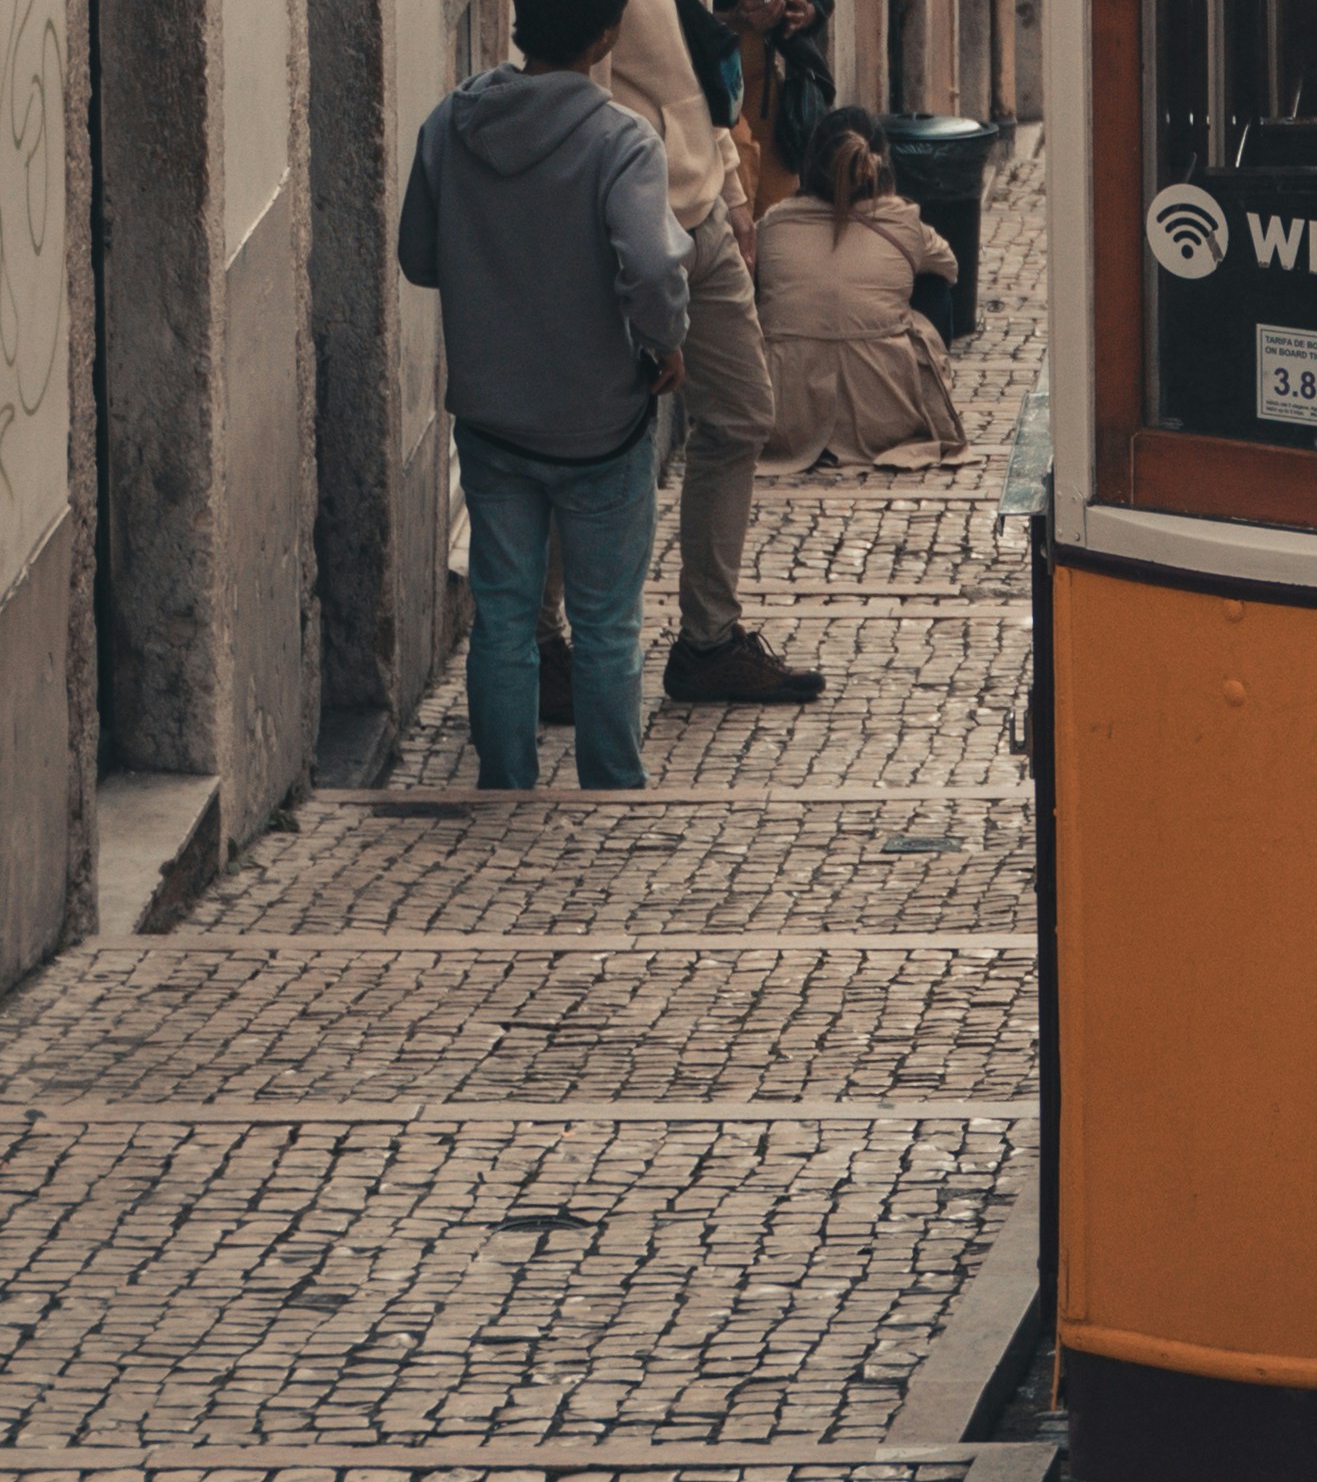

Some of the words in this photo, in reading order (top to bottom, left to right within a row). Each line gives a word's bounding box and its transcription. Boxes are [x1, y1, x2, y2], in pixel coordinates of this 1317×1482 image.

[1265, 335, 1293, 347] TARIFA
[1294, 339, 1305, 348] DE
[1265, 346, 1277, 355] ON
[1279, 348, 1308, 359] BOARD
